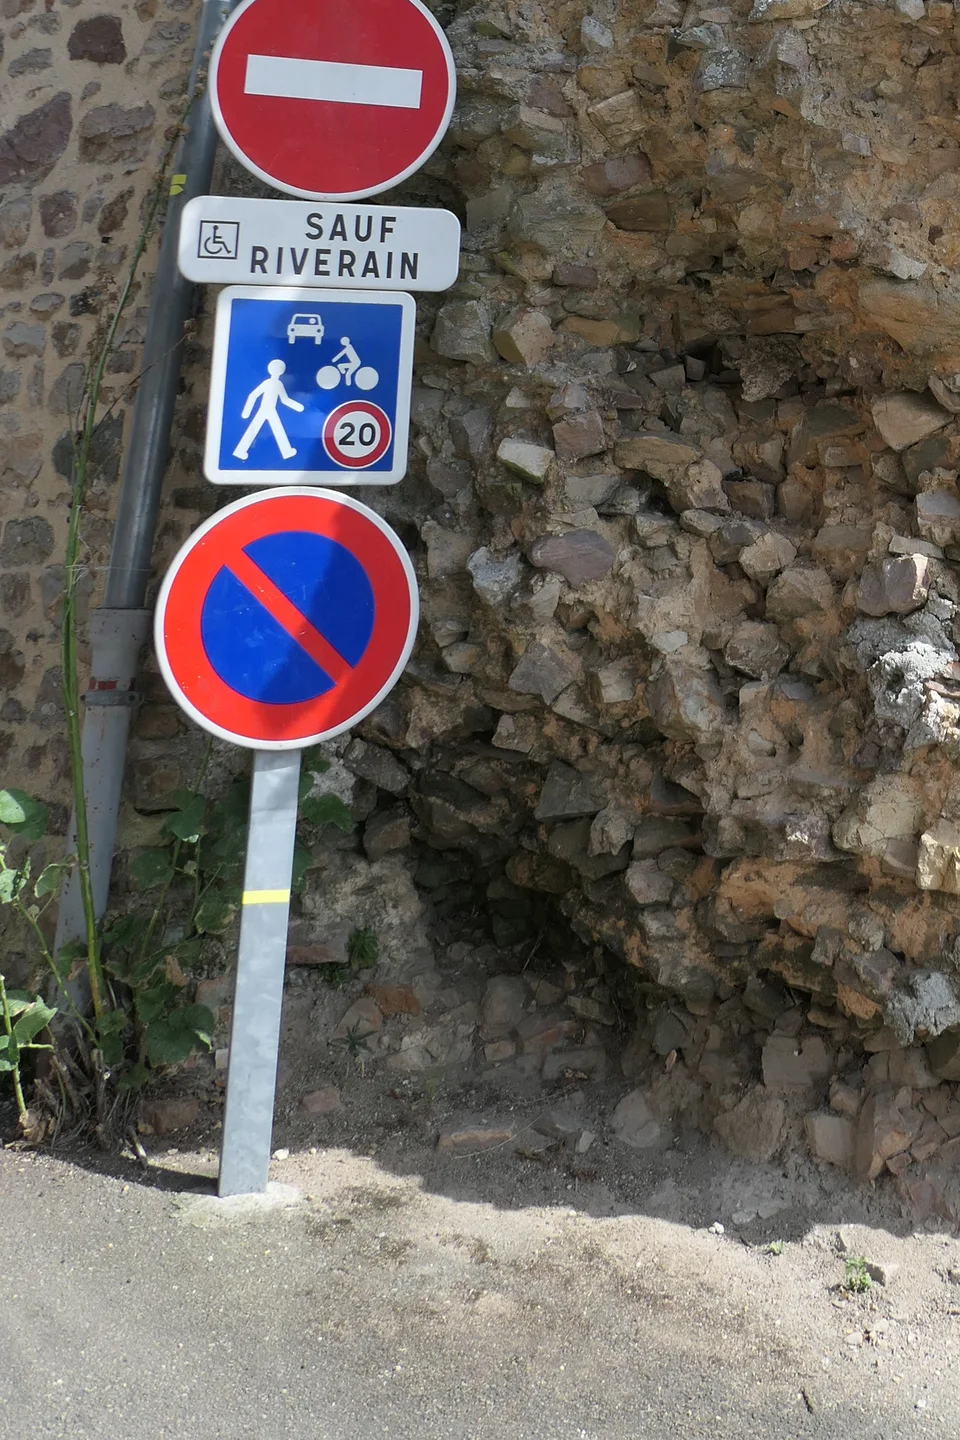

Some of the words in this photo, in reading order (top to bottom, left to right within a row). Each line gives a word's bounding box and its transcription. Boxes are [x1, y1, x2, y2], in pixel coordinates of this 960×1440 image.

[305, 212, 397, 243] SAUF
[250, 246, 419, 280] RIVERAIN
[338, 422, 376, 446] 20
